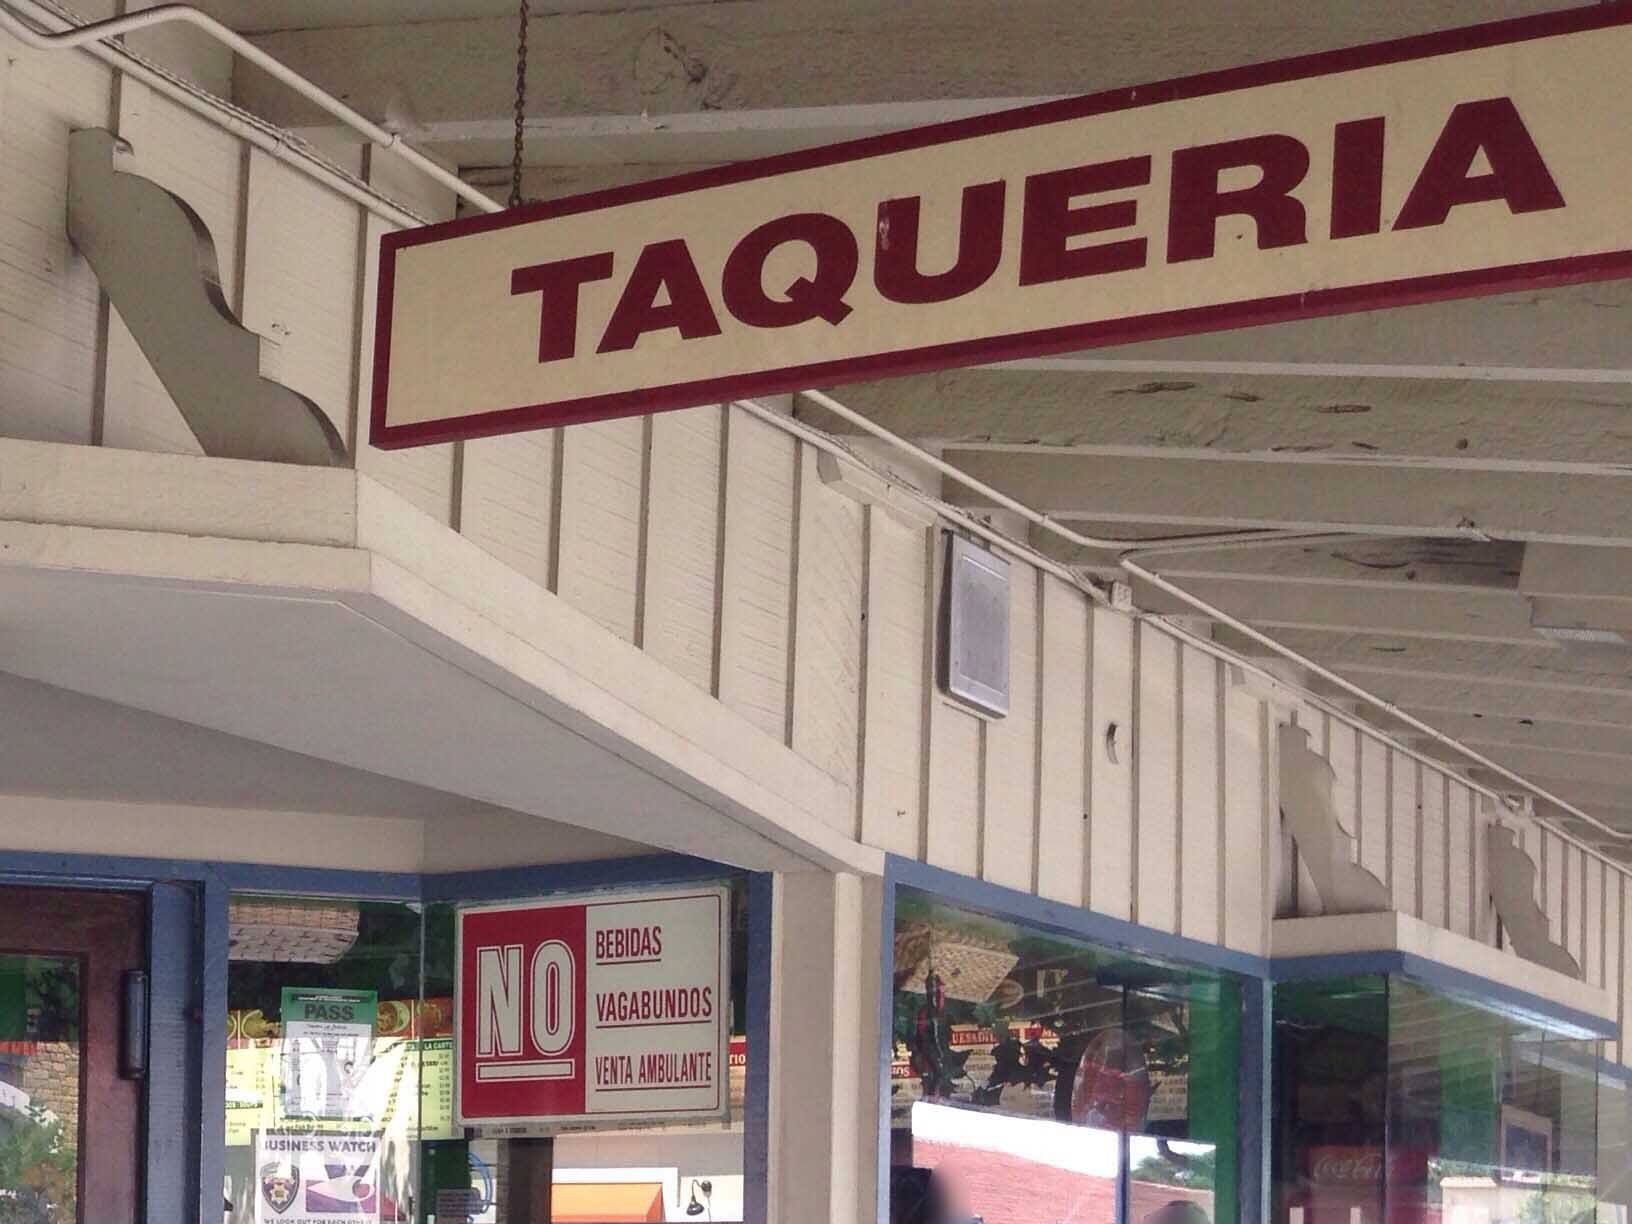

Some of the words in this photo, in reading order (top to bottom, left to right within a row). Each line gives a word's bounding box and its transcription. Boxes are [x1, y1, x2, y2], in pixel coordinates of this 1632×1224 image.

[511, 96, 1567, 365] TAQUERIA
[595, 925, 662, 959] BEBIDAS
[304, 1003, 354, 1021] PASS
[475, 939, 576, 1058] NO
[595, 987, 712, 1022] VAGABUNDOS
[595, 1056, 633, 1085] VENTA
[638, 1052, 712, 1084] AMBULANTE
[328, 1141, 376, 1153] WATCH
